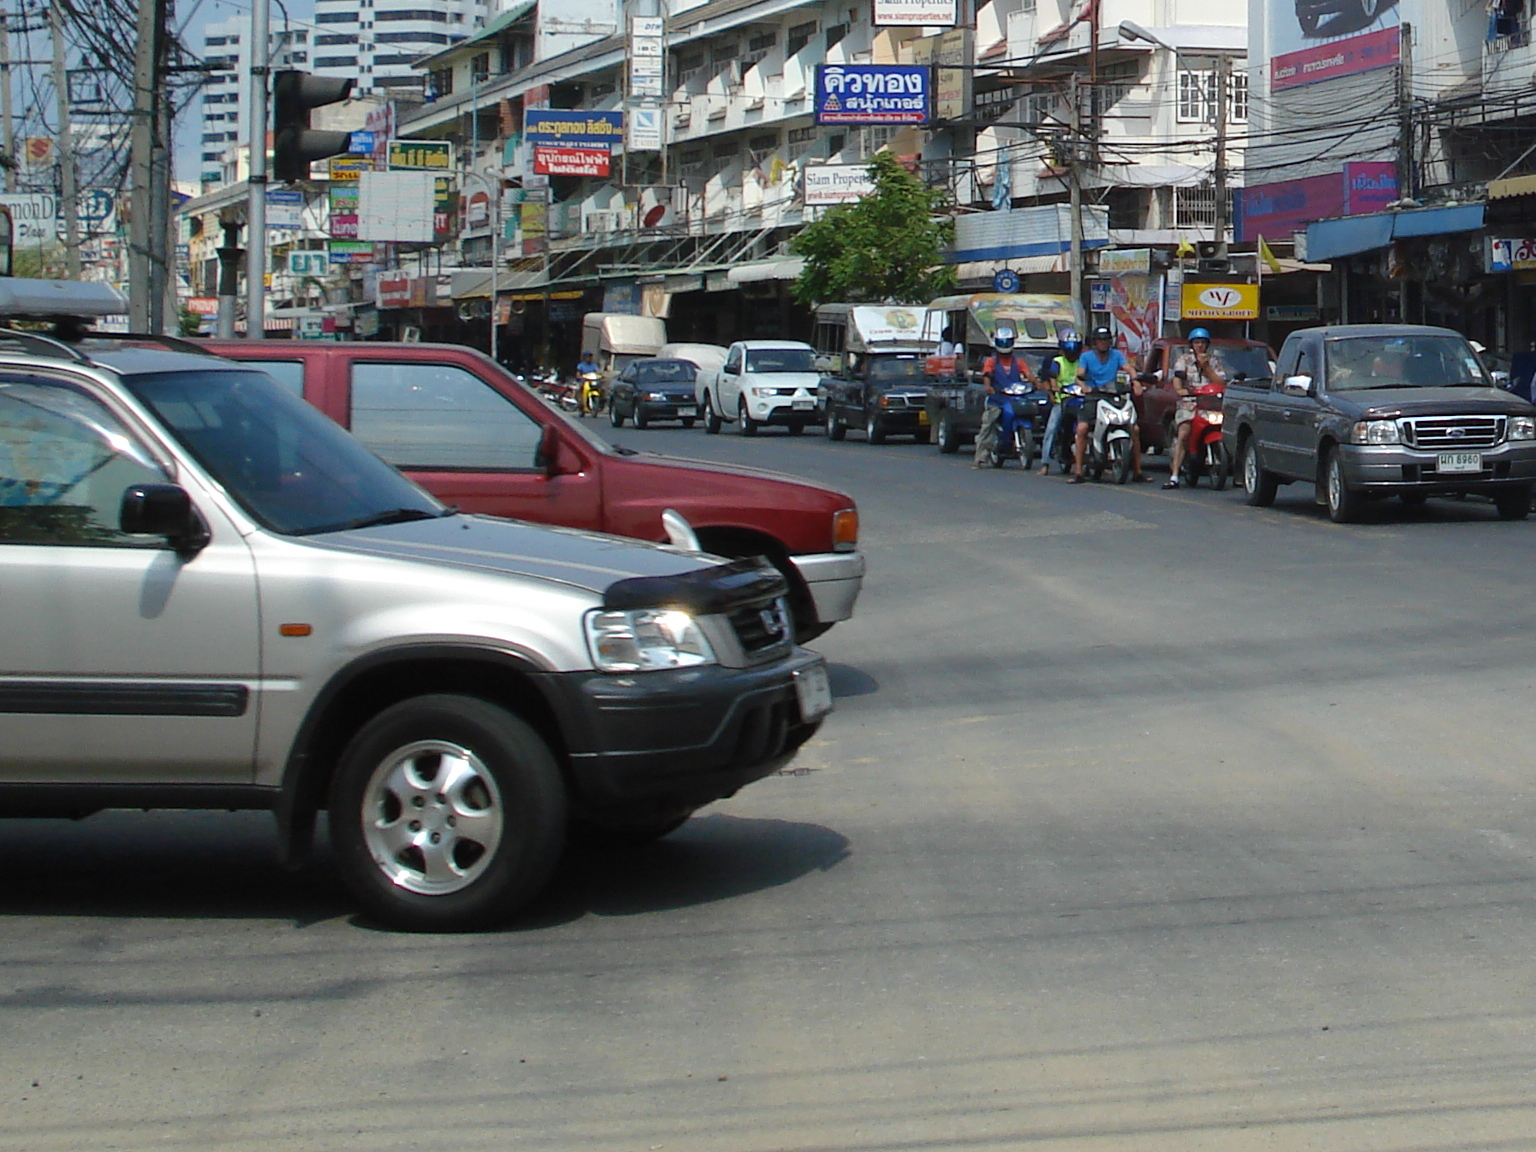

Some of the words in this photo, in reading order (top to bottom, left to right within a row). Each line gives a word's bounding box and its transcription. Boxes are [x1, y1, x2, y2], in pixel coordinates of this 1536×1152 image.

[824, 66, 922, 94] คิวทอง
[806, 173, 830, 186] Siam
